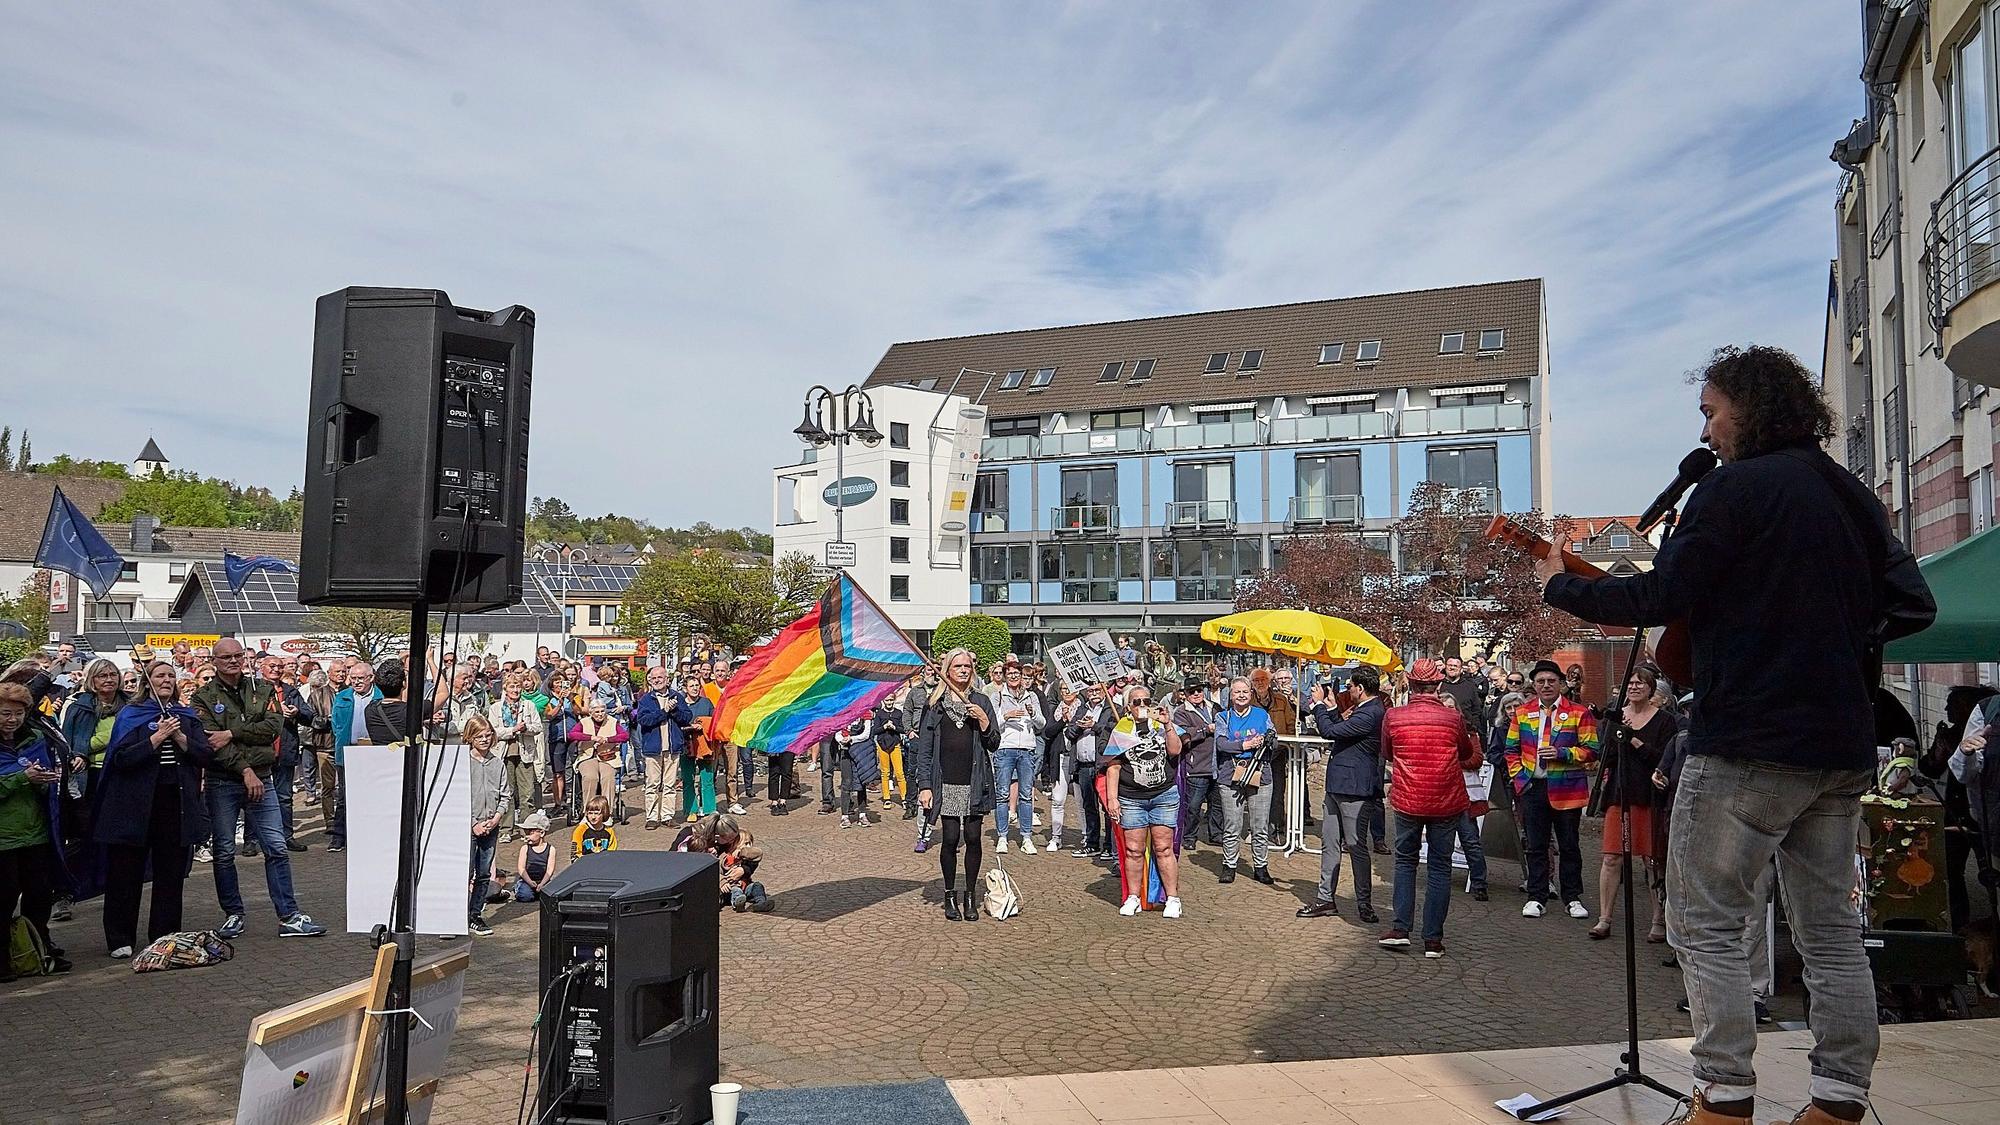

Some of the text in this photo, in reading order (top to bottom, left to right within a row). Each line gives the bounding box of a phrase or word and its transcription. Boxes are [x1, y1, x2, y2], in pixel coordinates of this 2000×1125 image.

[1272, 633, 1302, 645] UWV
[1055, 644, 1078, 659] BJÖRN
[1345, 643, 1370, 655] UWV
[1060, 654, 1083, 669] HÖCKE
